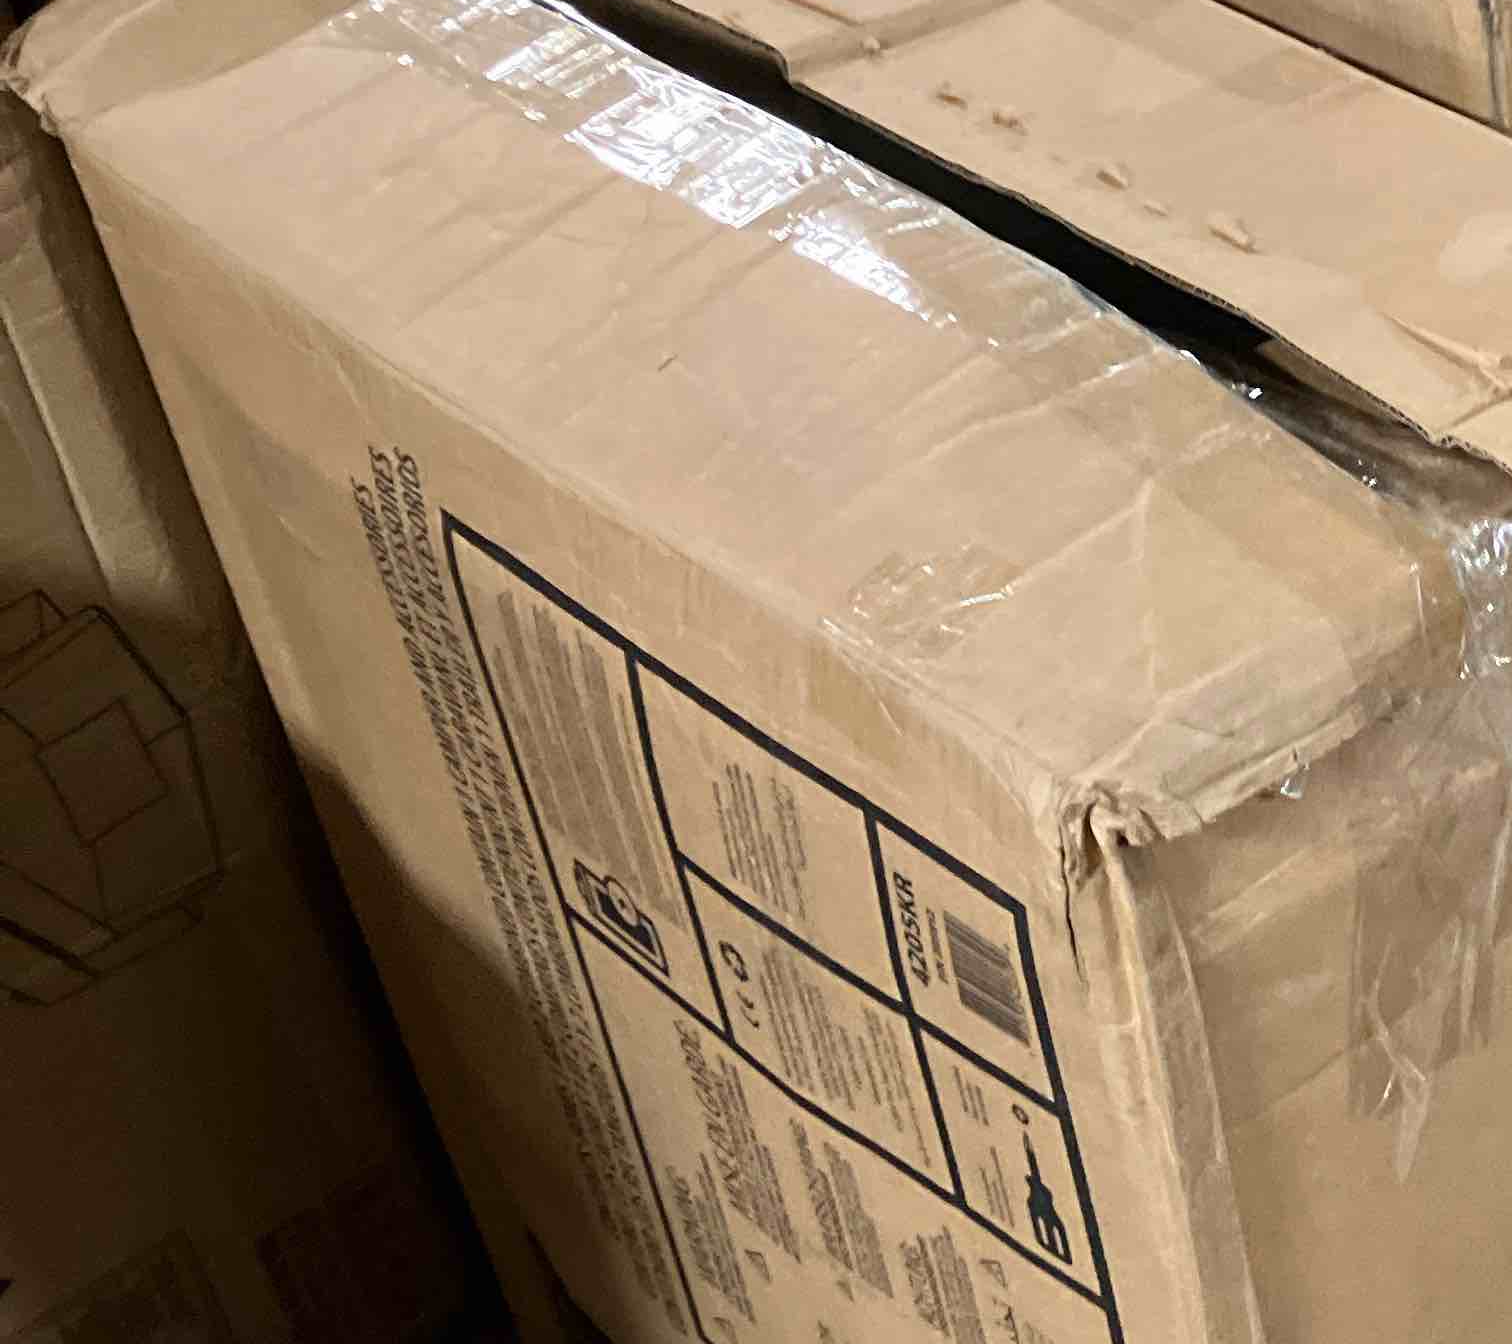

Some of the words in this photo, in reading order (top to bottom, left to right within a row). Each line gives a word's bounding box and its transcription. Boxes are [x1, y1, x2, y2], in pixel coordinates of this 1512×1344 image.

[351, 473, 415, 635] ACCESSORIES
[368, 445, 426, 610] ACCESSOIRES
[394, 445, 448, 607] ACCESORIOS
[892, 871, 930, 990] 4205KR
